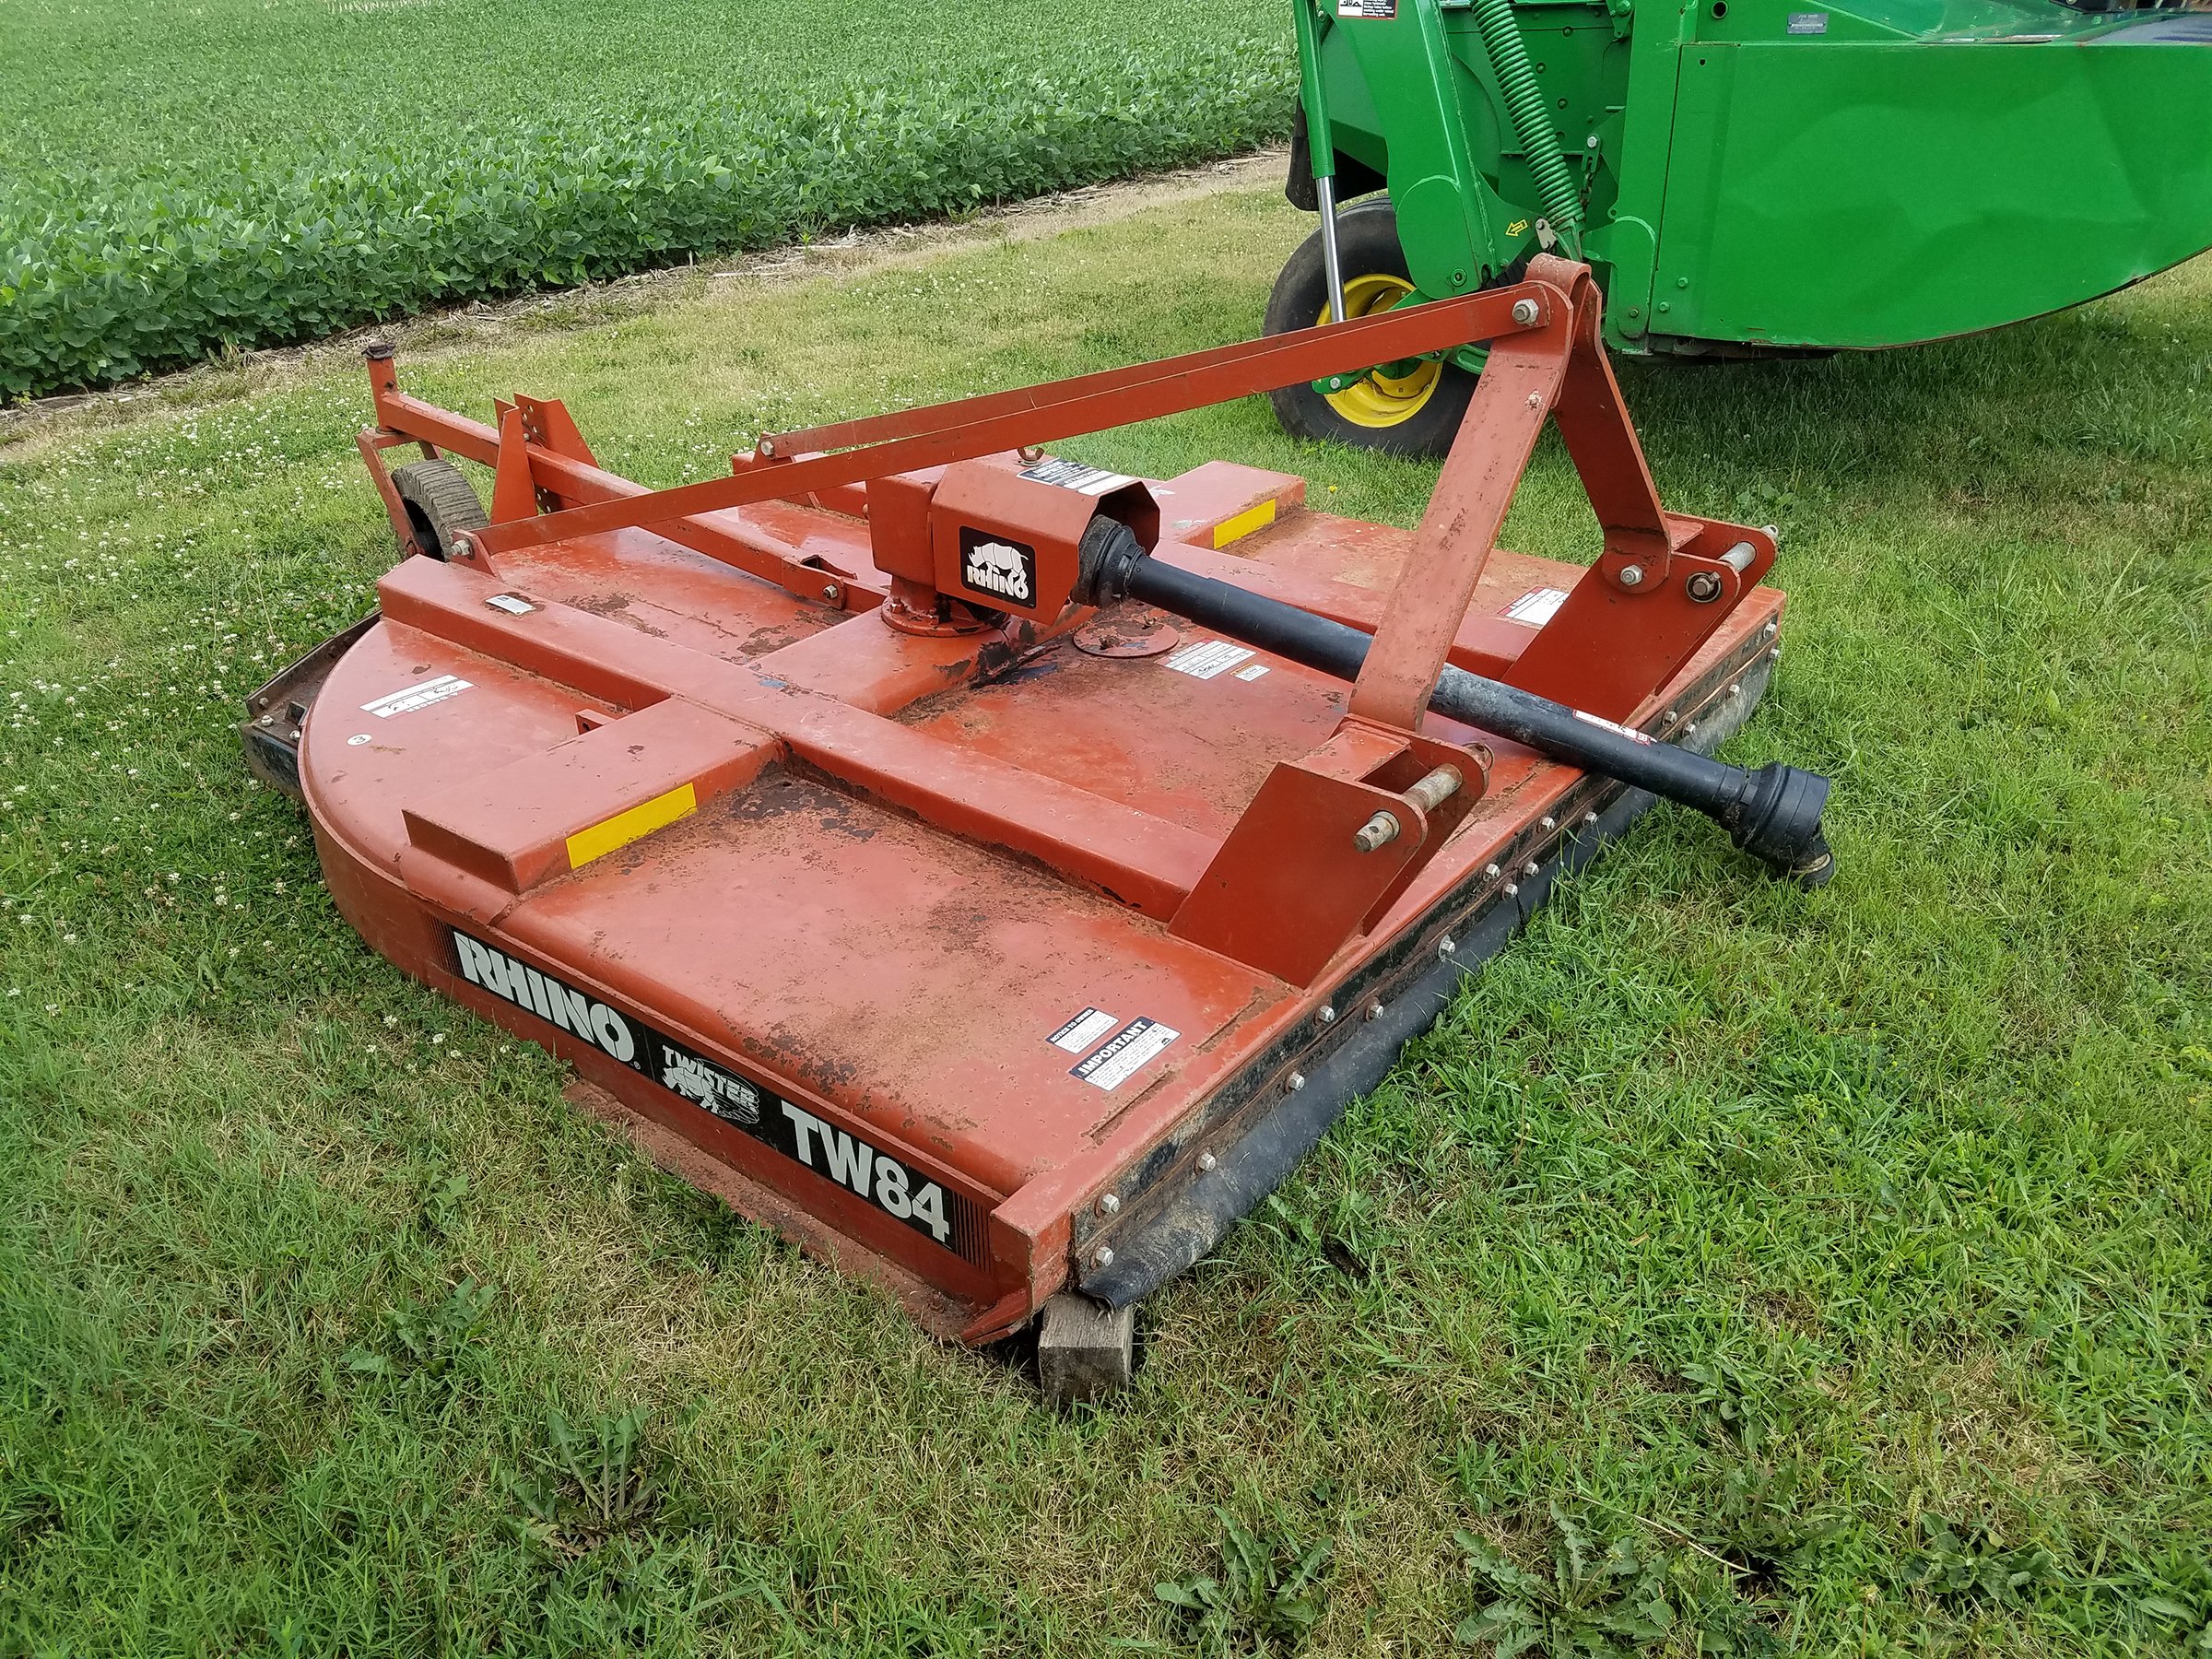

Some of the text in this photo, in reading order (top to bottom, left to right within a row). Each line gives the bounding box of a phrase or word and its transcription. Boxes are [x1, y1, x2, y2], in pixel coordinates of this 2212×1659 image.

[967, 564, 1030, 600] RHINO
[453, 931, 635, 1062] RHINO
[1066, 1021, 1077, 1030] TO
[662, 1044, 758, 1112] TWISTER
[1077, 1020, 1147, 1076] IMPORTANT
[782, 1100, 950, 1242] TW84
